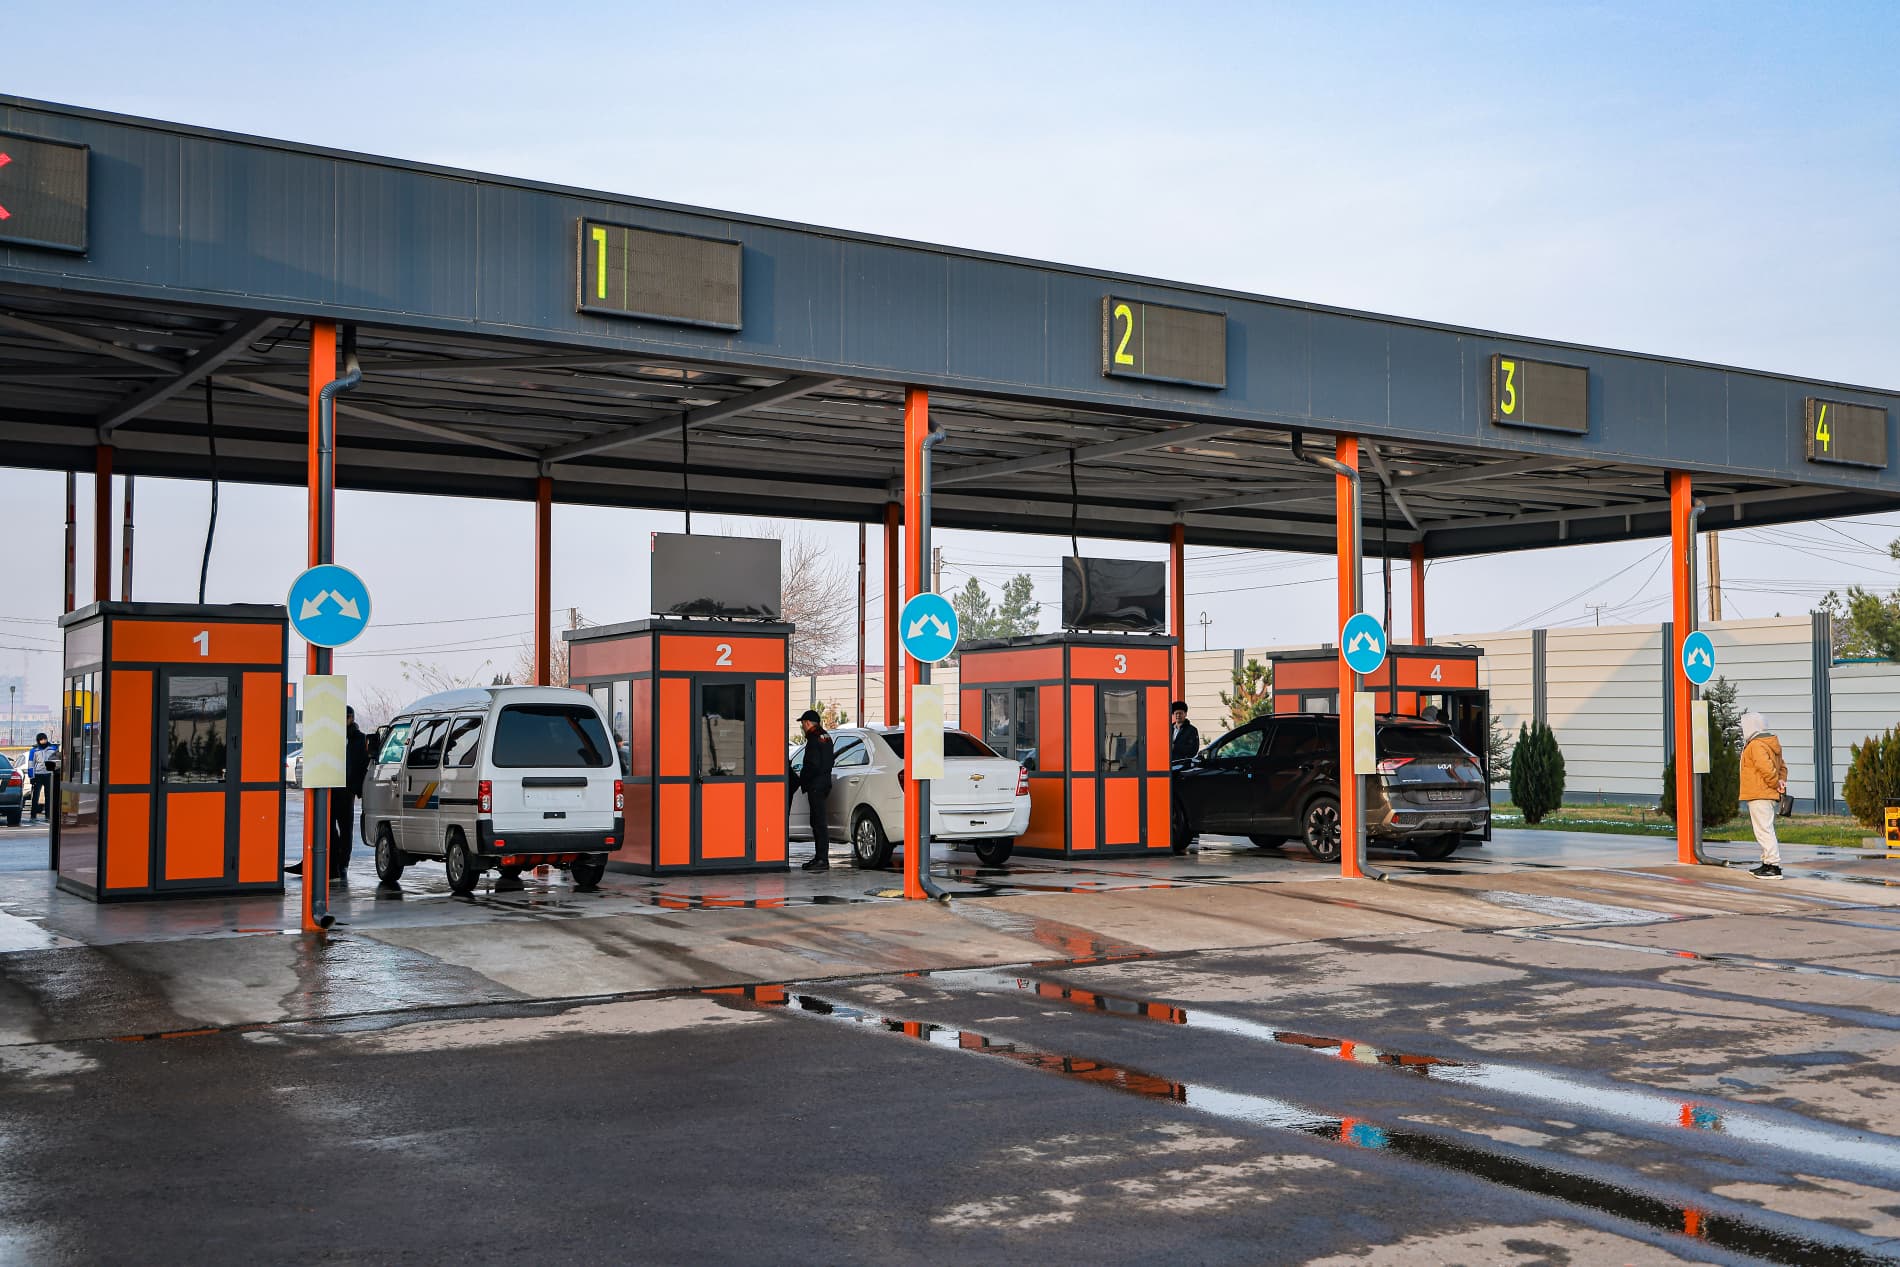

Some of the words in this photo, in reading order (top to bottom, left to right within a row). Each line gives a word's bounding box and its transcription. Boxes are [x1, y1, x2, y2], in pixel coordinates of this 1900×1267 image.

[591, 227, 607, 300] 1
[1113, 303, 1135, 366] 2
[1500, 359, 1517, 415] 3
[1815, 404, 1831, 452] 4
[192, 630, 210, 657] 1
[715, 643, 733, 666] 2
[1113, 654, 1128, 674] 3
[1430, 664, 1442, 682] 4
